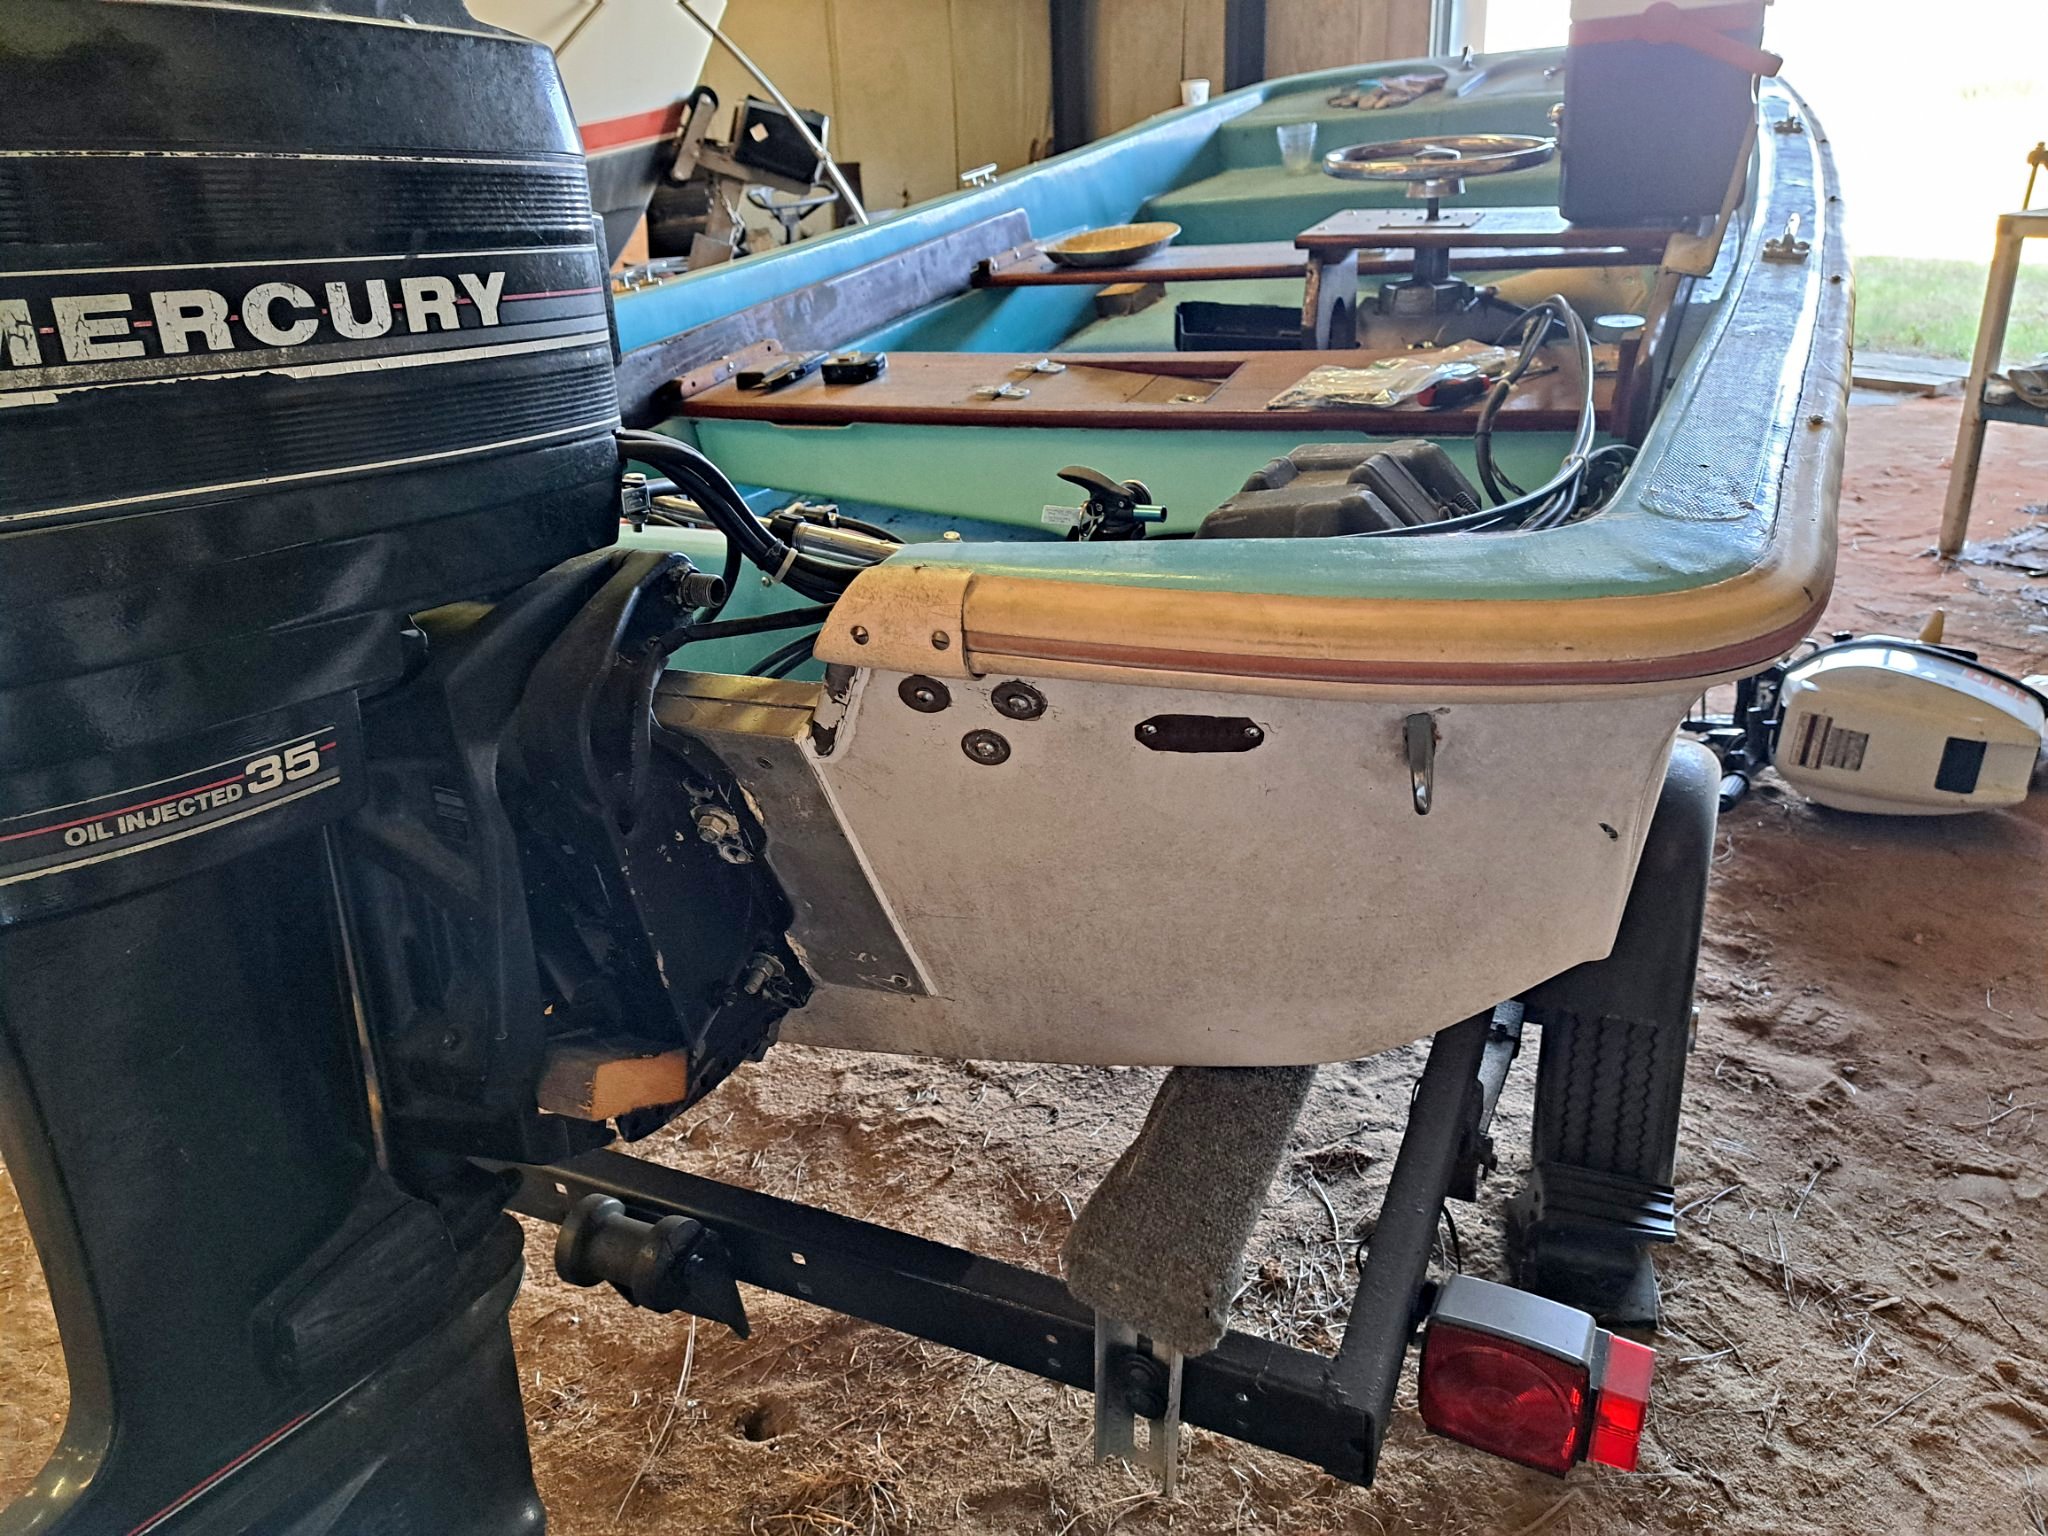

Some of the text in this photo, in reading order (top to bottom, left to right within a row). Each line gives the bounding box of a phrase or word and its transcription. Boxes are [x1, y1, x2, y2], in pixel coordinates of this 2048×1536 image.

[64, 740, 320, 847] OIL INJECTED 35
